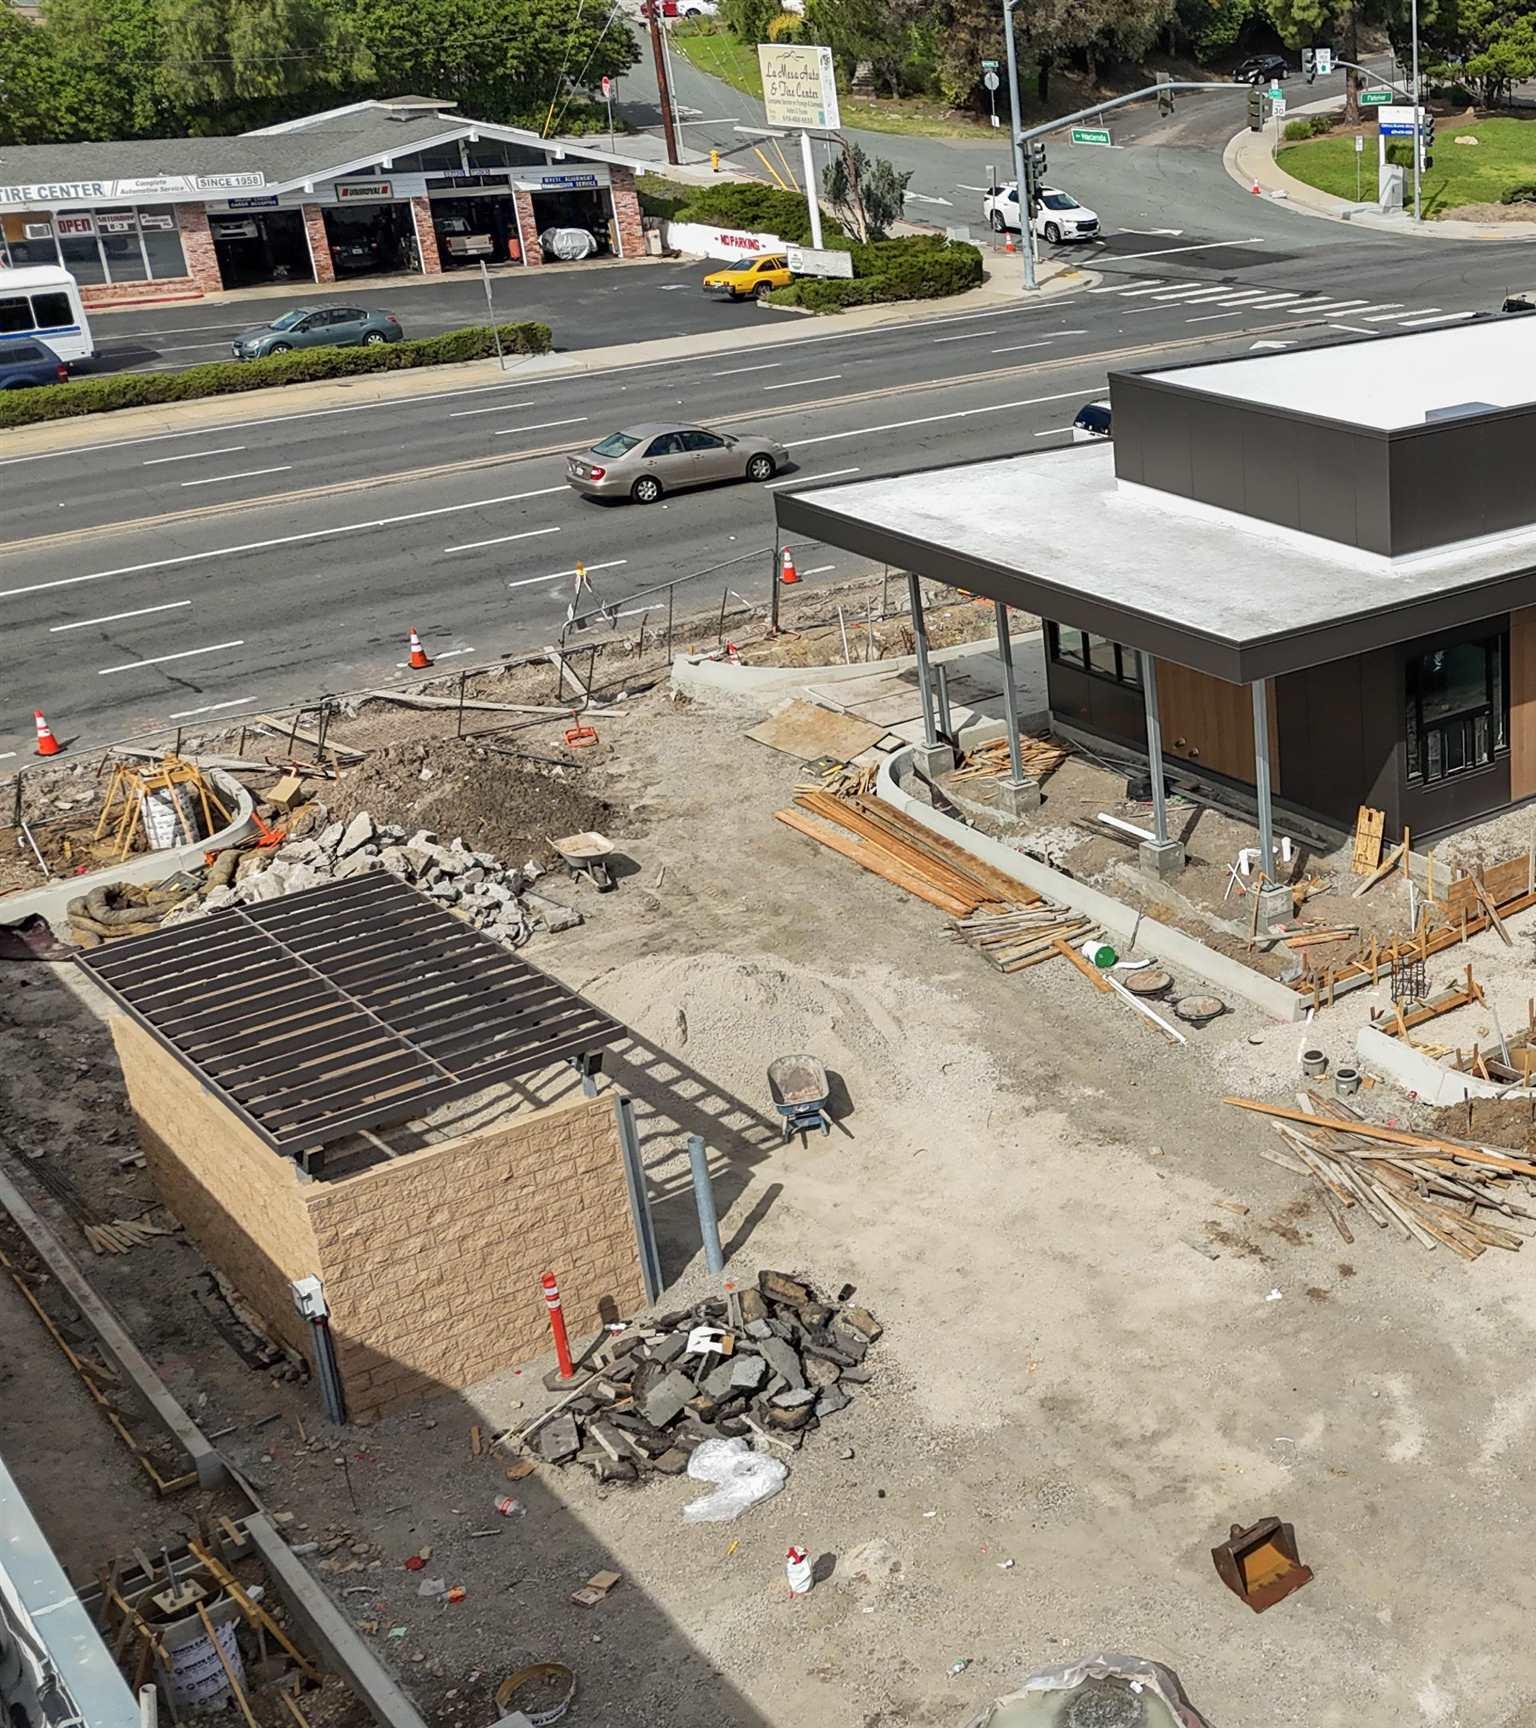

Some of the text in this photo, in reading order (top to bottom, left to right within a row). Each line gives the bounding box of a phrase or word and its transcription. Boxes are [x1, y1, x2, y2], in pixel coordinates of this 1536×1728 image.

[778, 63, 799, 80] Mesa
[800, 63, 820, 81] Auto
[779, 80, 795, 97] Tire
[797, 82, 819, 99] Center
[200, 176, 259, 188] SINCE 1958
[37, 182, 104, 200] CENTER
[58, 218, 92, 234] OPEN
[720, 234, 760, 251] NO PARKING
